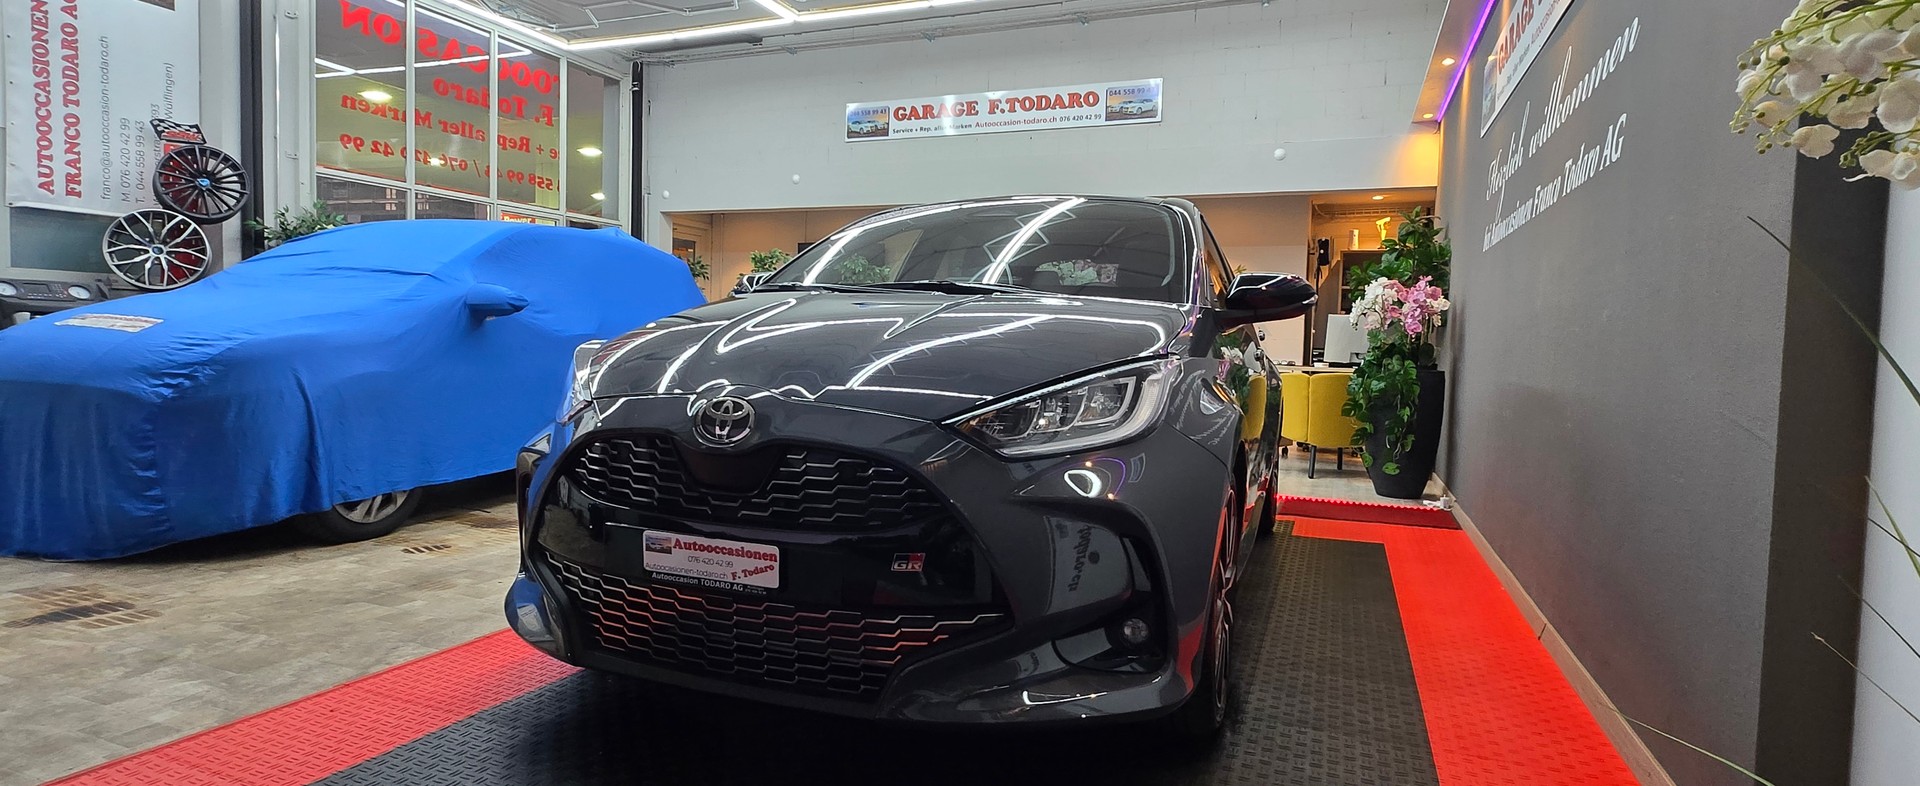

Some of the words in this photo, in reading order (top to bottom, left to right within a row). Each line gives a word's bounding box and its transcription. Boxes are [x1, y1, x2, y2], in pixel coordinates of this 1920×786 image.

[60, 0, 78, 20] A
[60, 22, 80, 108] TODARO
[30, 0, 54, 195] AUTOOCCASIONEN
[1123, 88, 1136, 96] 558
[893, 101, 979, 121] GARAGE
[1487, 101, 1530, 224] Herzlich
[1529, 17, 1641, 158] willkommen
[119, 117, 131, 132] 99
[134, 120, 146, 134] 43
[892, 127, 914, 135] Service
[974, 118, 1057, 129] Autooccasion-todaro.ch
[1059, 115, 1071, 123] 076
[1072, 114, 1084, 122] 420
[1085, 113, 1093, 121] 42
[120, 132, 131, 146] 42
[135, 135, 146, 149] 99
[63, 112, 82, 199] FRANCO
[120, 146, 131, 168] 420
[135, 150, 146, 168] 558
[1532, 184, 1562, 219] Franco
[1562, 143, 1601, 197] Todaro
[1600, 113, 1628, 171] AG
[120, 169, 131, 189] 076
[135, 170, 146, 191] 044
[673, 538, 778, 563] Autooccasionen
[688, 556, 701, 564] 076
[702, 558, 714, 566] 420
[894, 560, 922, 570] GR
[652, 572, 699, 584] Autooccasion
[700, 578, 731, 590] TODARO
[732, 583, 744, 591] AG
[731, 571, 741, 581] F.
[742, 565, 775, 578] Todaro
